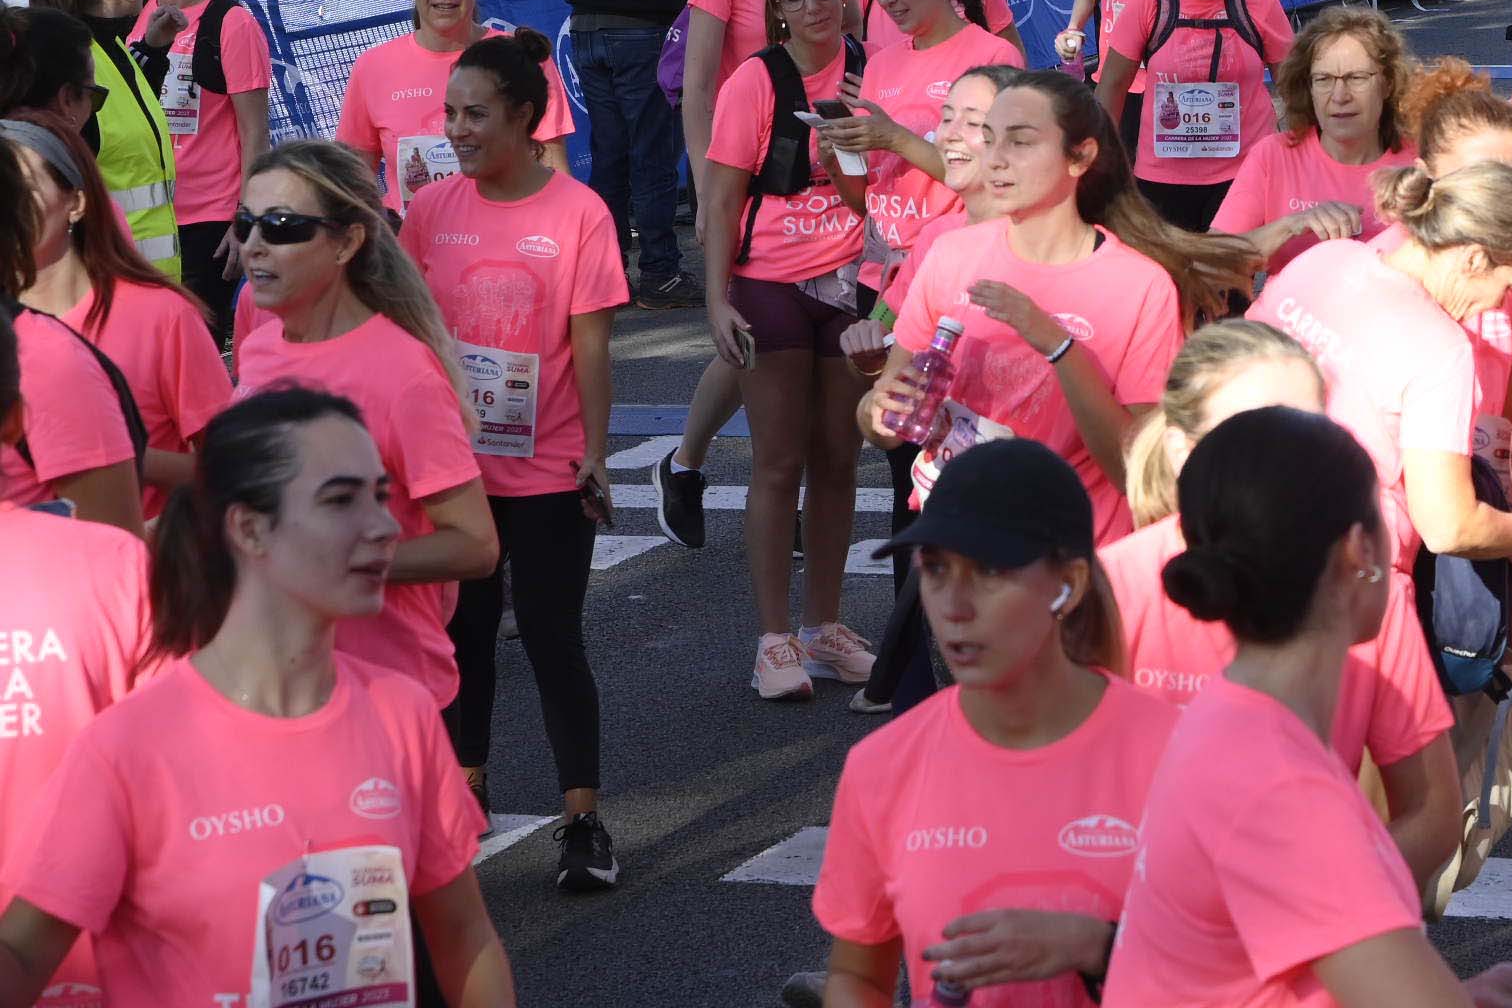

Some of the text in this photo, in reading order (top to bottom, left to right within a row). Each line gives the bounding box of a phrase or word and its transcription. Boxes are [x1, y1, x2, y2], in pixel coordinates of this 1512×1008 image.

[391, 86, 433, 102] OYSHO
[1182, 112, 1211, 124] 016
[783, 215, 858, 236] SUMA
[435, 232, 480, 246] OYSHO
[469, 388, 495, 406] 16
[188, 802, 286, 841] OYSHO
[905, 825, 989, 853] OYSHO
[278, 933, 337, 973] 016
